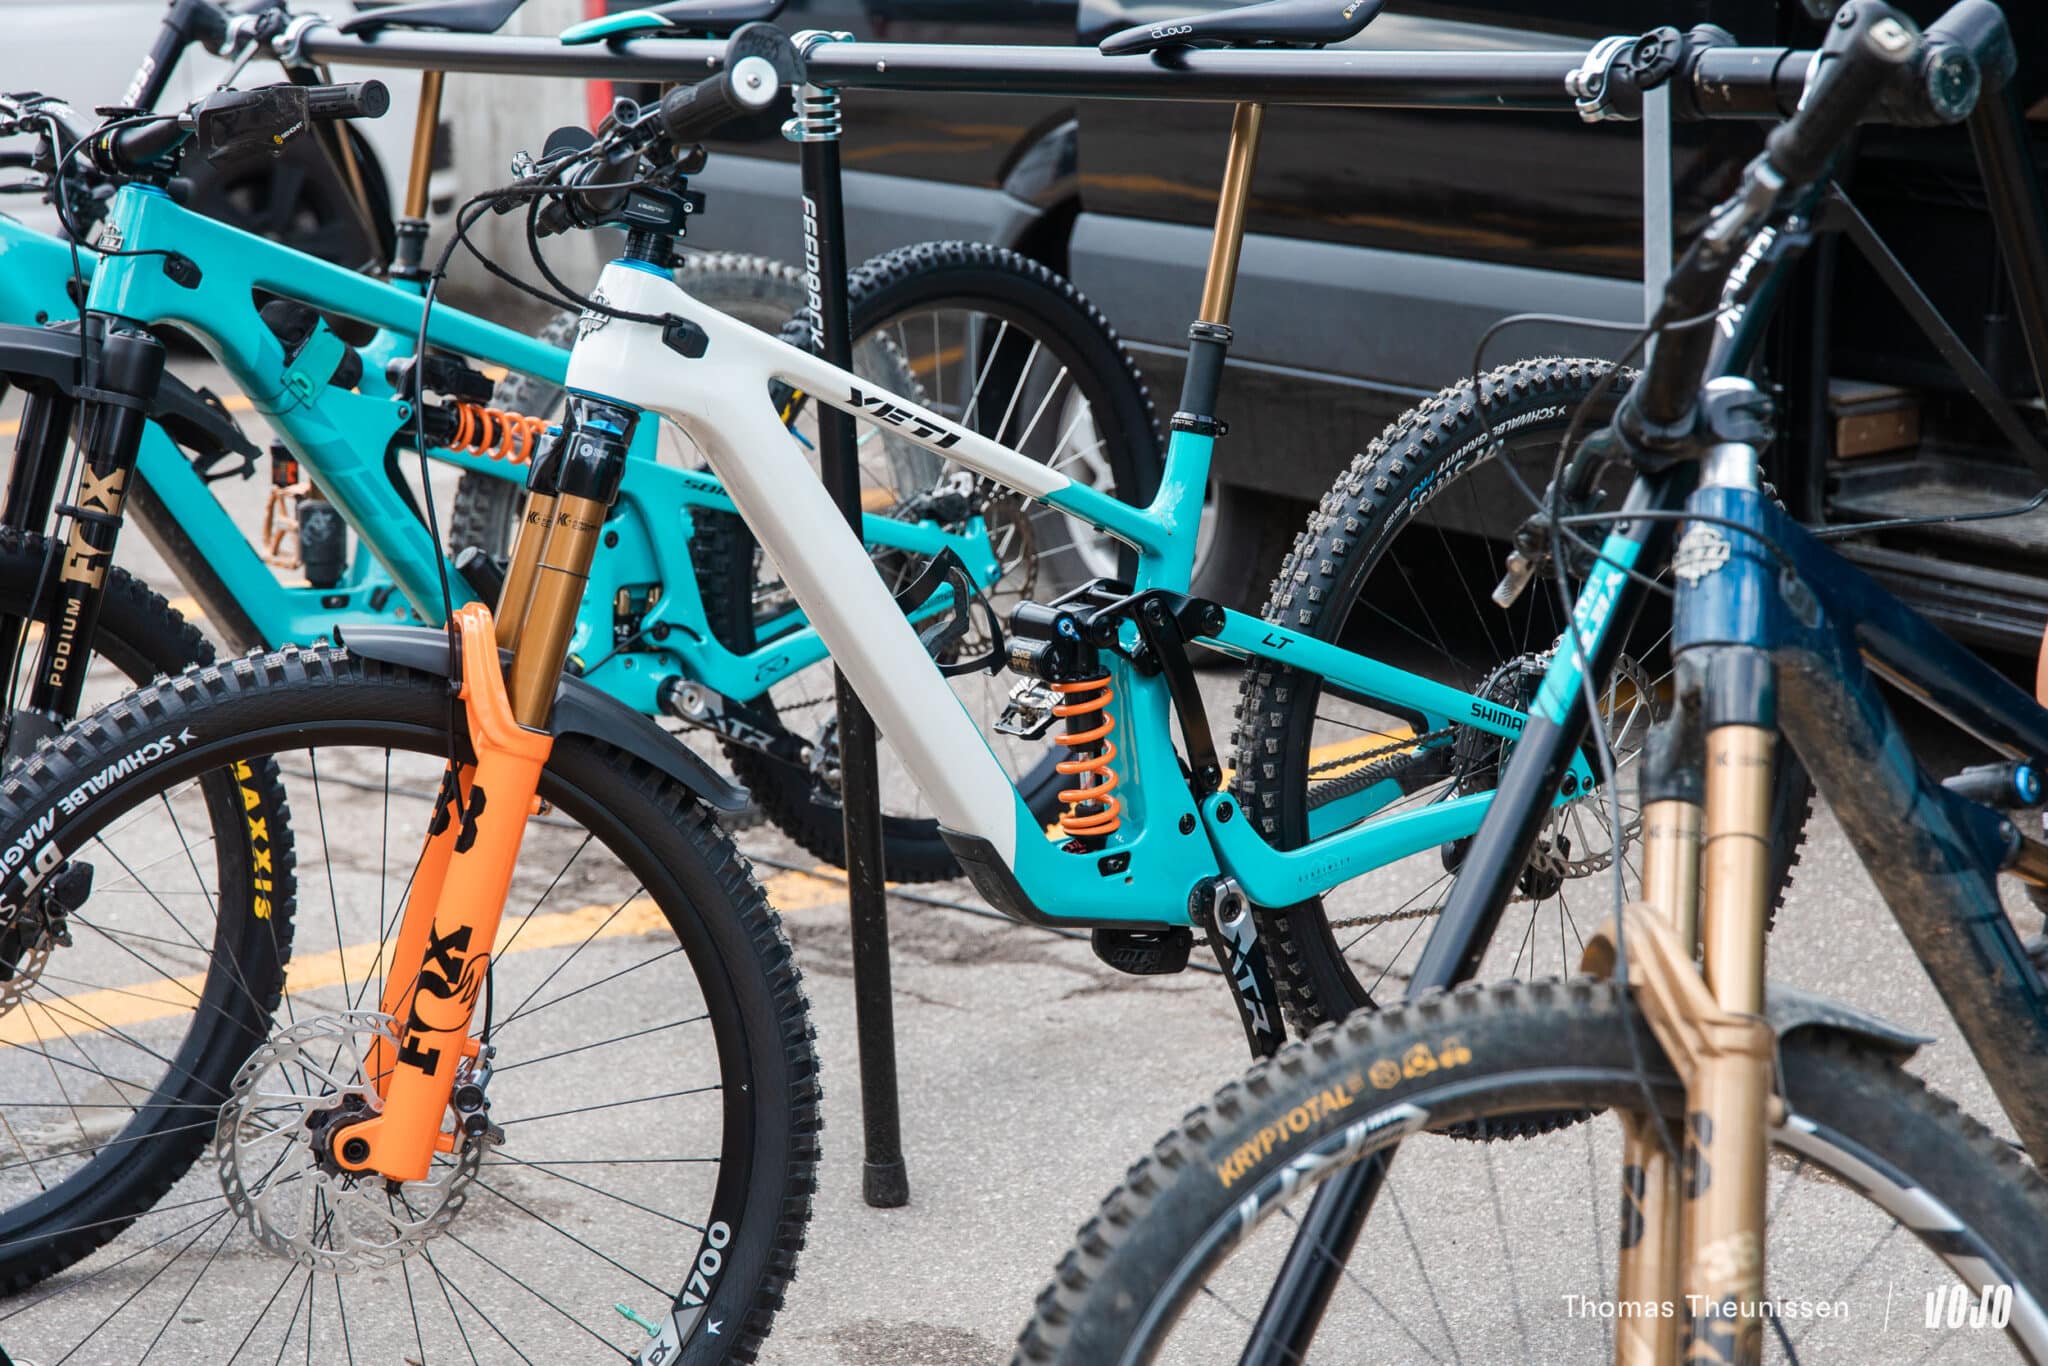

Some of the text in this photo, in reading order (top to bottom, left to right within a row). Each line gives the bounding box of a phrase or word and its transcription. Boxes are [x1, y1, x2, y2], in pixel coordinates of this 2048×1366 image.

[1151, 25, 1192, 39] CLOUD
[802, 194, 825, 349] FEEDBACK
[846, 386, 961, 448] YETI
[49, 598, 82, 687] PODIUM
[1261, 632, 1295, 649] LT
[1470, 702, 1527, 732] SHIMA
[0, 735, 177, 885] SCHWALBE MAGI
[230, 758, 273, 921] MAXXIS
[18, 839, 64, 898] DT
[397, 916, 476, 1077] FOX
[1216, 1082, 1355, 1190] KRYPTOTAL
[682, 1220, 731, 1306] 1700
